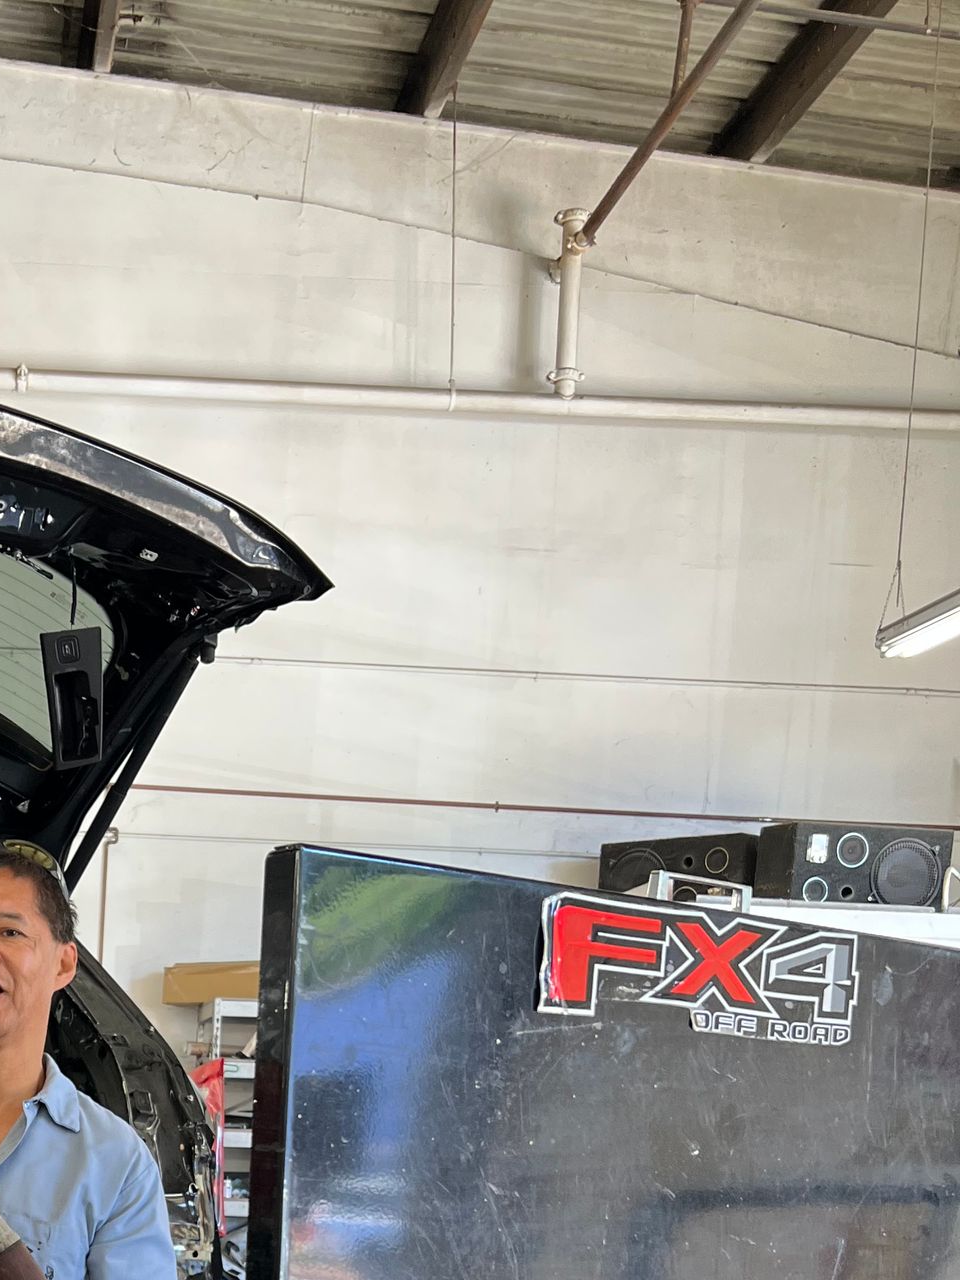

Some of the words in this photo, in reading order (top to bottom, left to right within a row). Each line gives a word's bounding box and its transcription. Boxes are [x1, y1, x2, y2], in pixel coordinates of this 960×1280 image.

[538, 892, 859, 1026] FX4
[692, 1011, 757, 1037] OFF
[768, 1021, 852, 1046] ROAD
